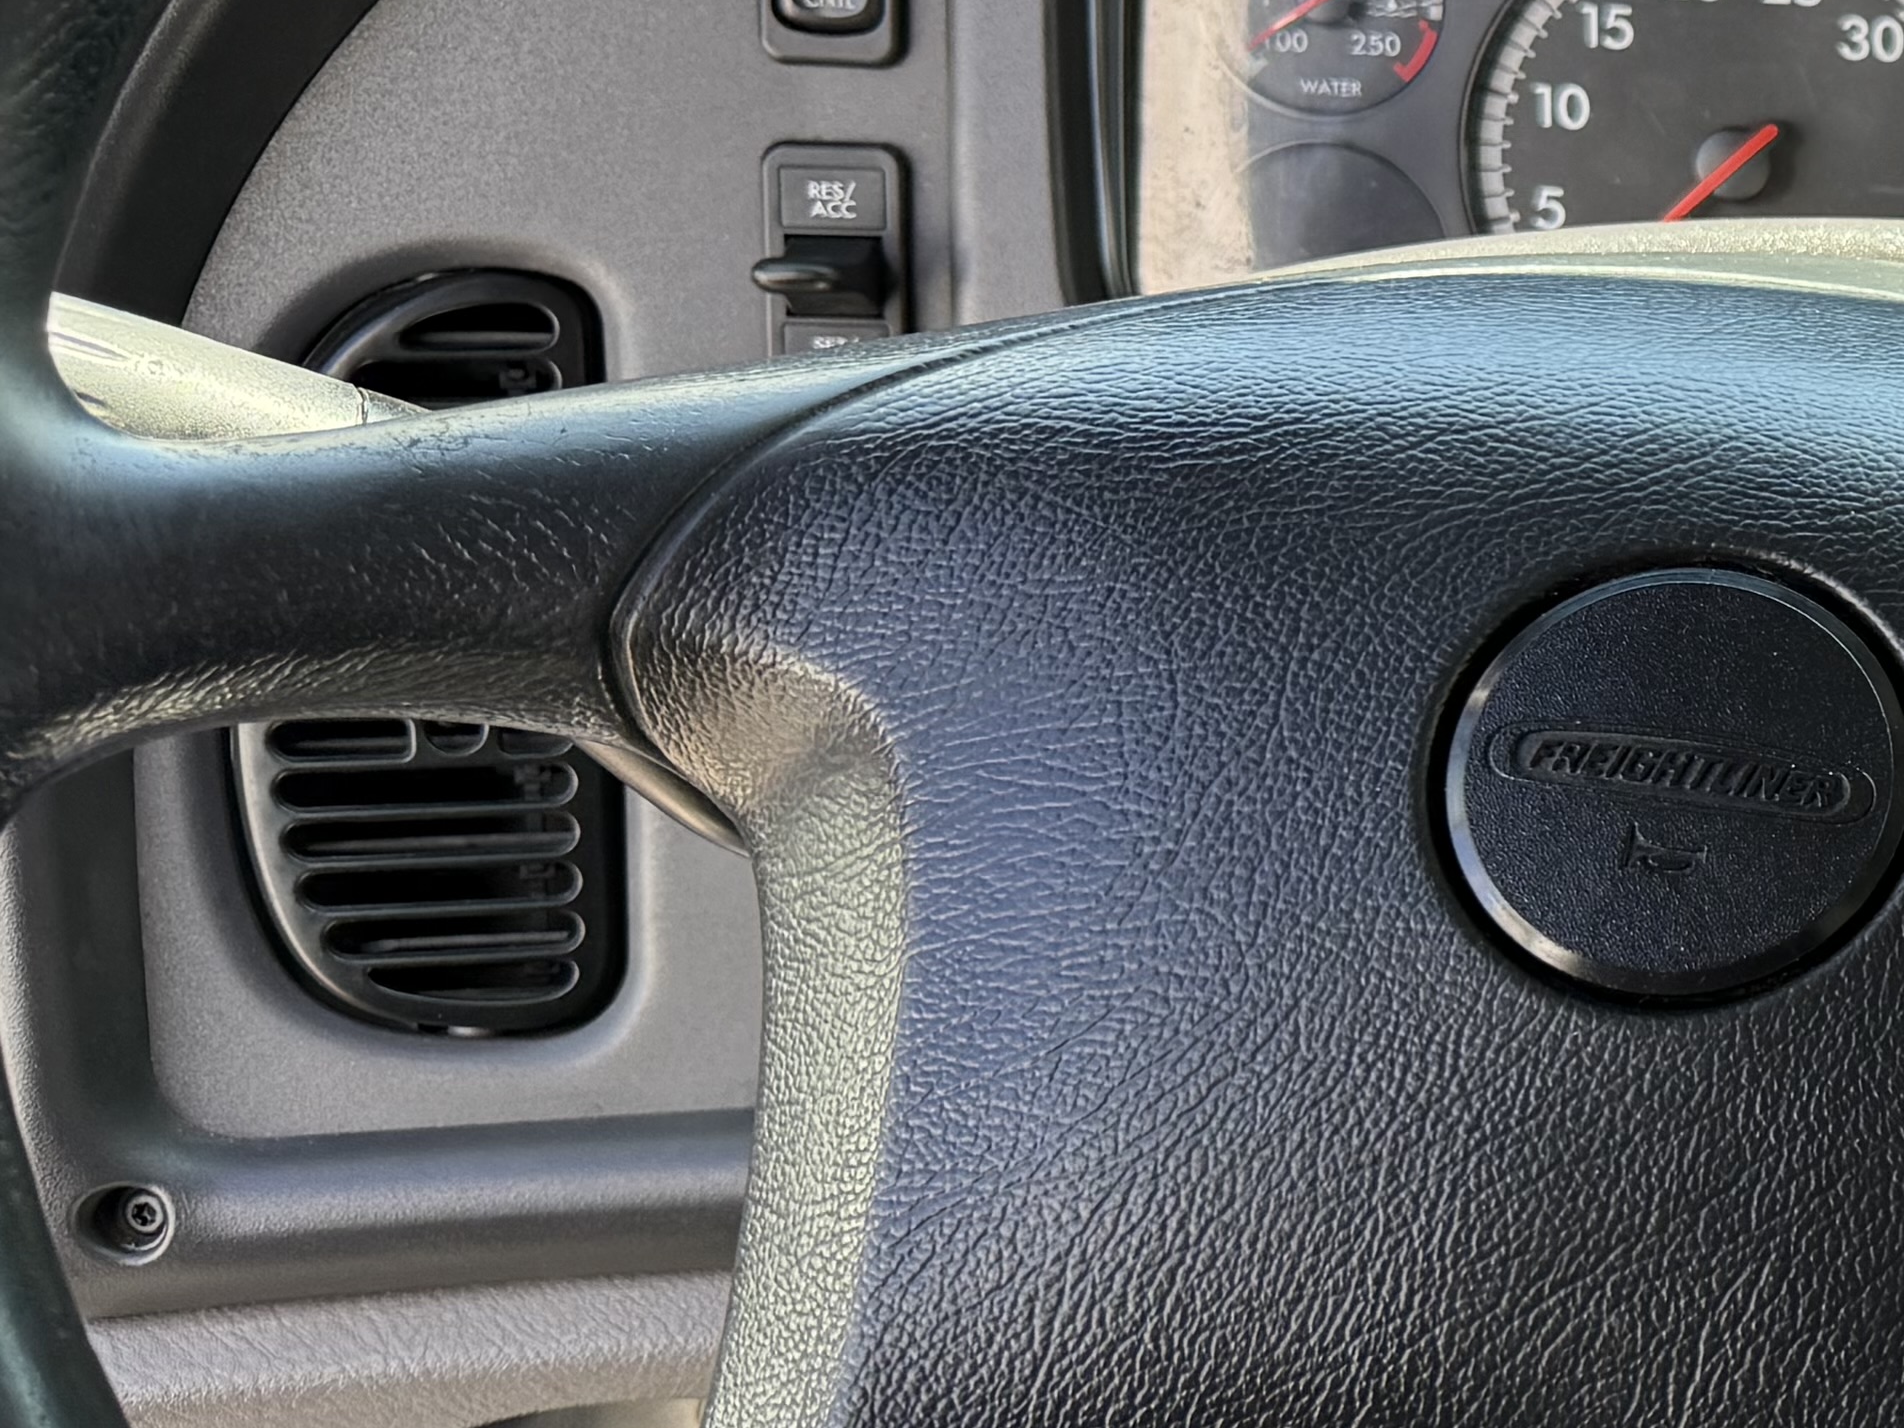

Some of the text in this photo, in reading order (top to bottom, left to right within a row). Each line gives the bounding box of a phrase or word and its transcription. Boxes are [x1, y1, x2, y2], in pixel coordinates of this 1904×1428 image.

[1350, 31, 1401, 57] 250
[1582, 4, 1635, 53] 15
[1300, 77, 1363, 98] WATER
[1533, 83, 1592, 131] 10
[807, 179, 856, 202] RES/
[1531, 185, 1566, 230] 5
[810, 200, 857, 221] ACC
[1527, 738, 1836, 809] FREIGHTLINER
